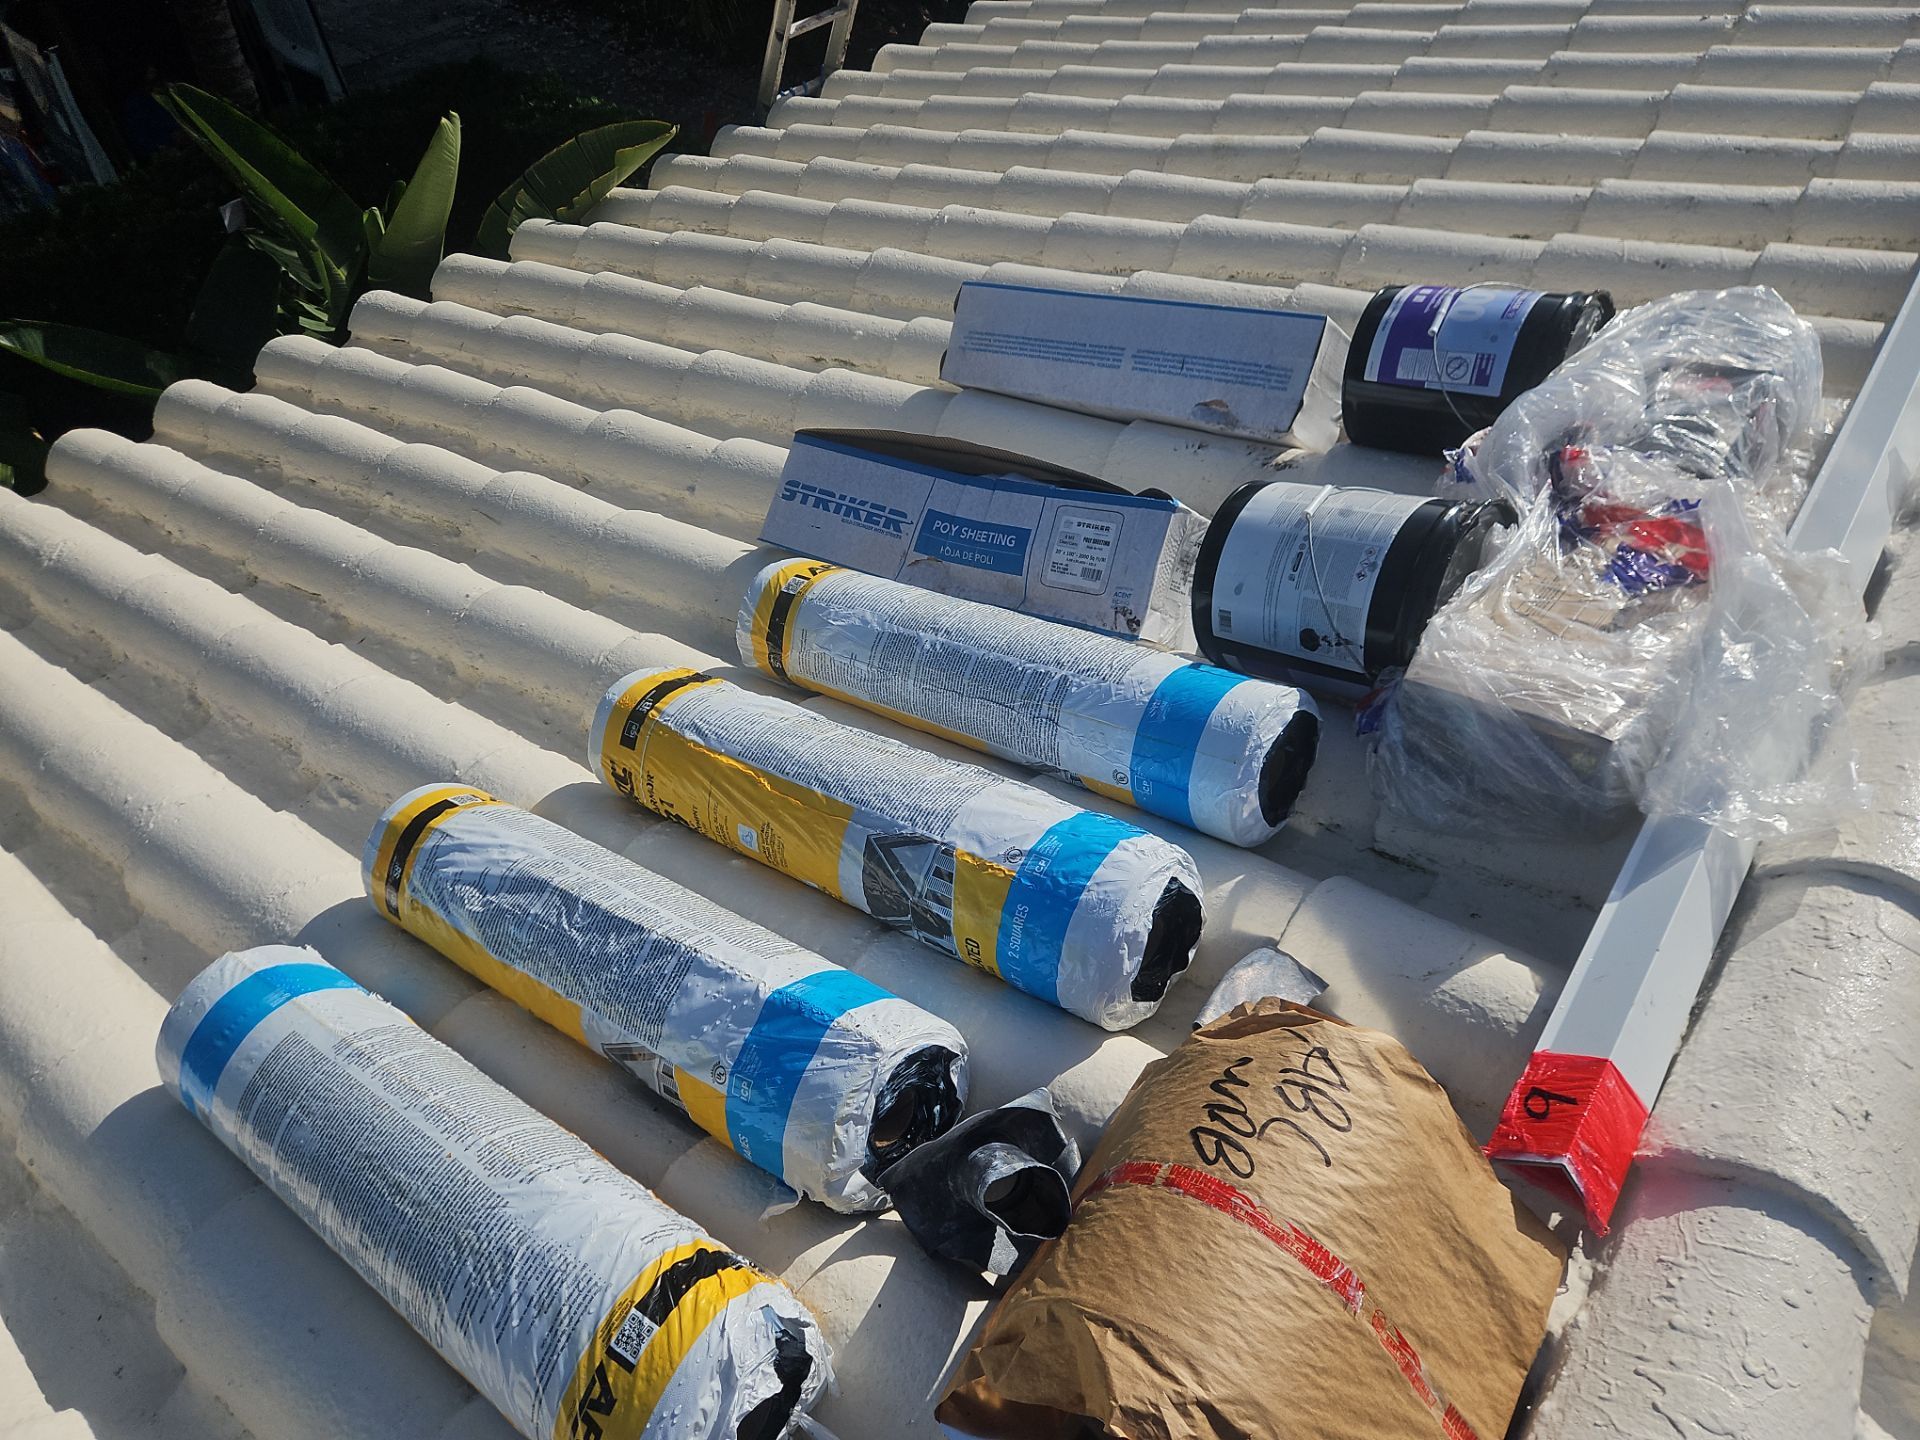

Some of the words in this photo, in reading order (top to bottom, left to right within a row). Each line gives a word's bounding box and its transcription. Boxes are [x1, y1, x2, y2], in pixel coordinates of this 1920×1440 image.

[781, 479, 913, 533] STRIKER
[1076, 521, 1111, 532] STRIKER
[960, 527, 1017, 547] SHEETING
[962, 551, 972, 561] DE
[974, 553, 994, 565] POLI
[1008, 903, 1029, 952] SQUARES
